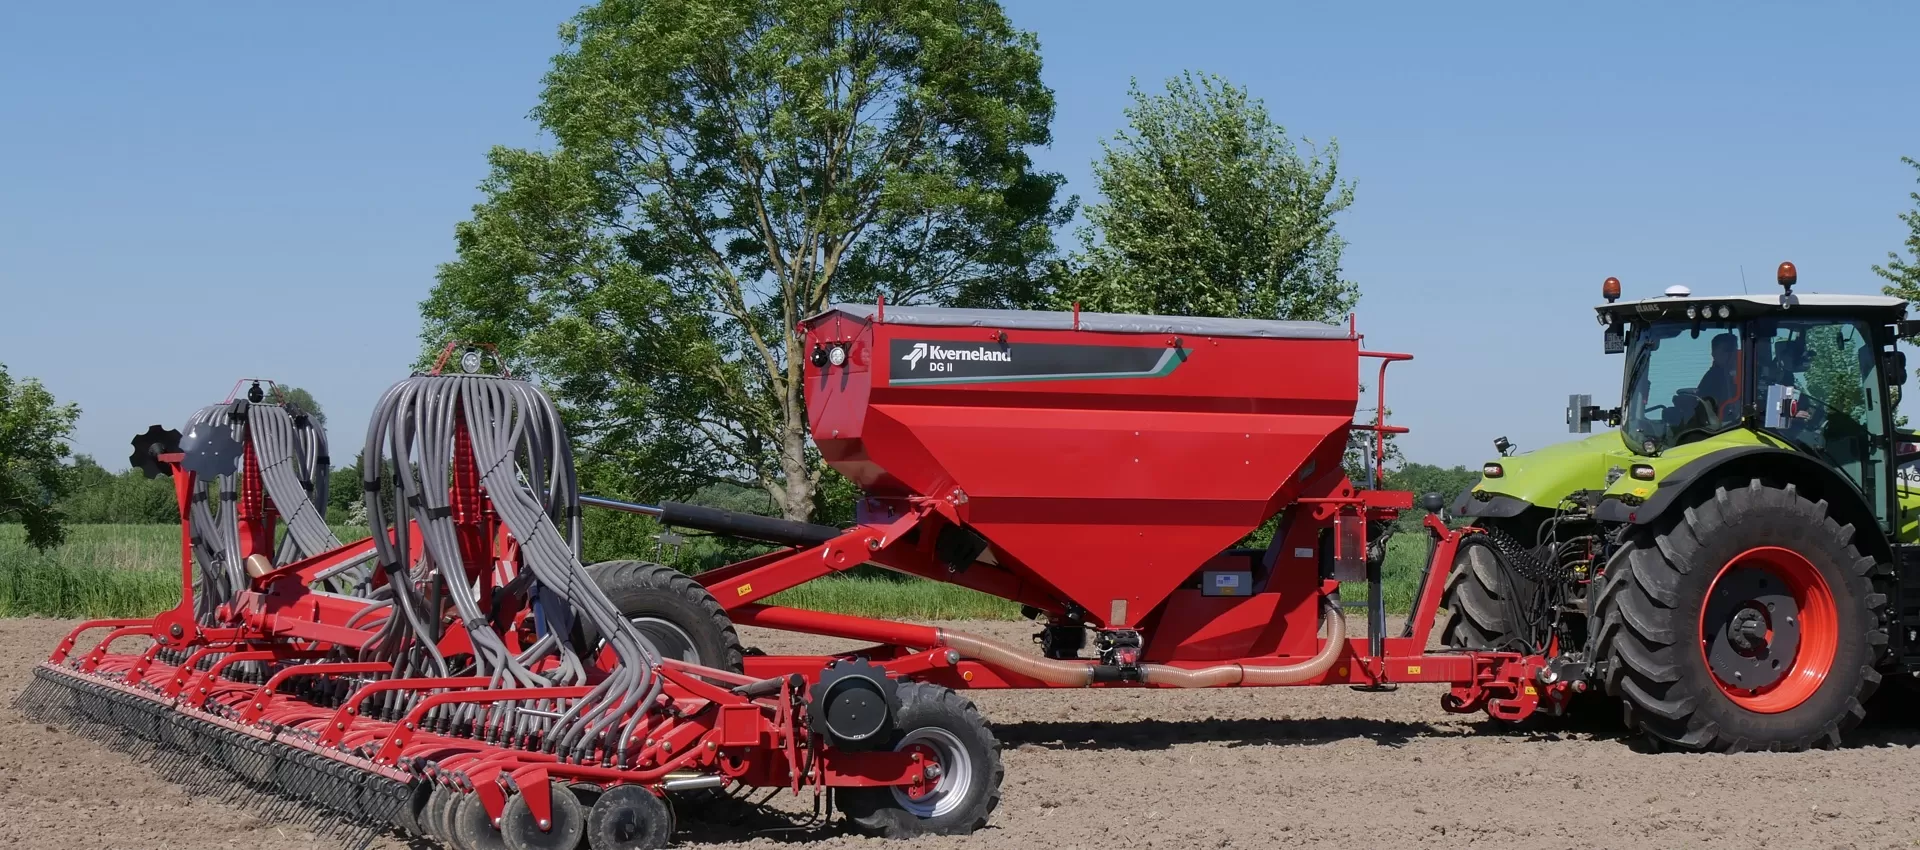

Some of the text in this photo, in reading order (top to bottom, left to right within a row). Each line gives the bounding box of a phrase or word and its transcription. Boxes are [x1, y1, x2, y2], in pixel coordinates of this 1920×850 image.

[930, 345, 1012, 362] Kverneland
[930, 362, 953, 372] DG II
